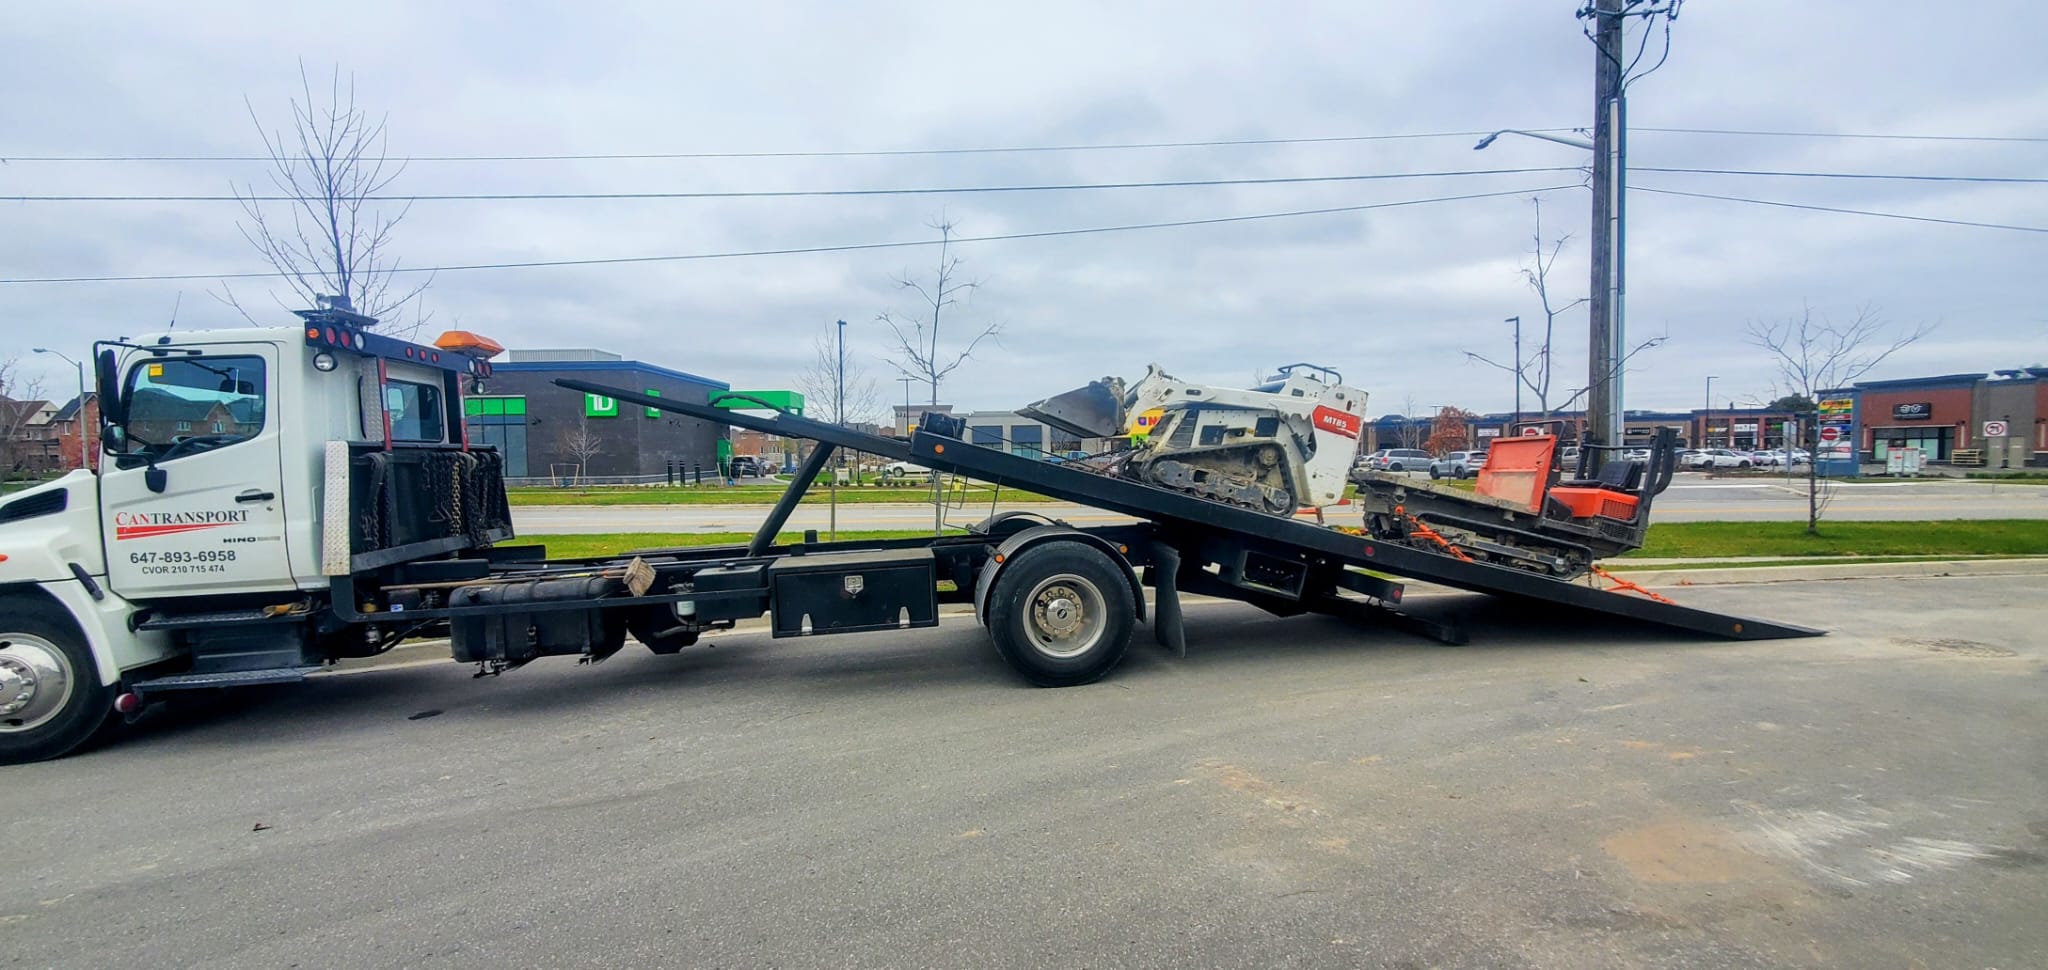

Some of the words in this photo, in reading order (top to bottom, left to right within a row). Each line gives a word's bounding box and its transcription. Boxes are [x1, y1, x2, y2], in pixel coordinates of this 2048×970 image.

[588, 393, 613, 411] TD
[1323, 415, 1347, 429] MT85
[130, 550, 236, 564] 647-893-6958
[142, 566, 170, 575] CVOR
[171, 565, 188, 574] 210
[191, 565, 206, 573] 715
[208, 564, 225, 573] 474
